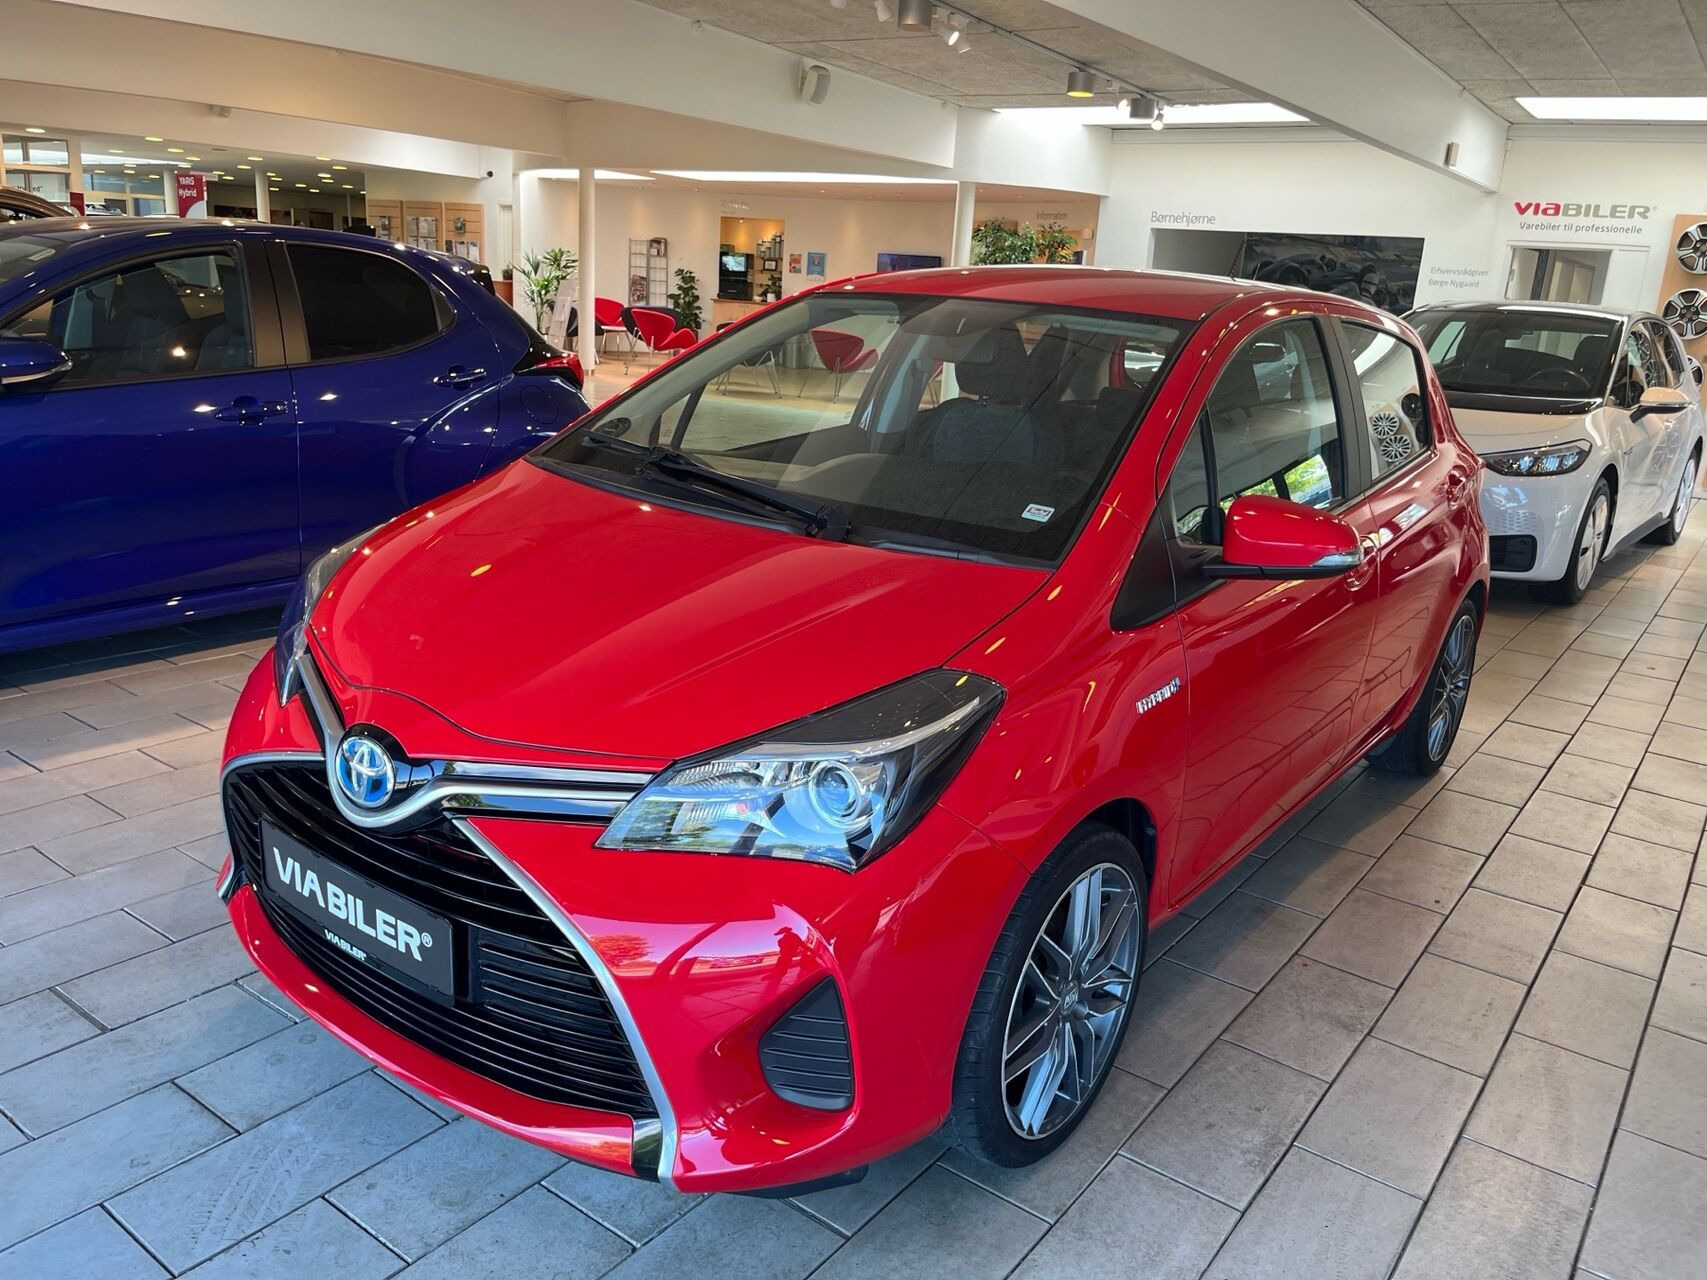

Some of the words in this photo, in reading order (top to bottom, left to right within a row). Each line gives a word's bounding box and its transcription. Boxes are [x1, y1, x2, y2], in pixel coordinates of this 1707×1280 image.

[178, 188, 197, 199] Hybrid
[1150, 211, 1216, 227] Børnehjørne
[1519, 222, 1560, 231] Varebiler
[1564, 223, 1573, 231] til
[1575, 224, 1643, 234] professionelle
[1135, 680, 1176, 714] HYBRID
